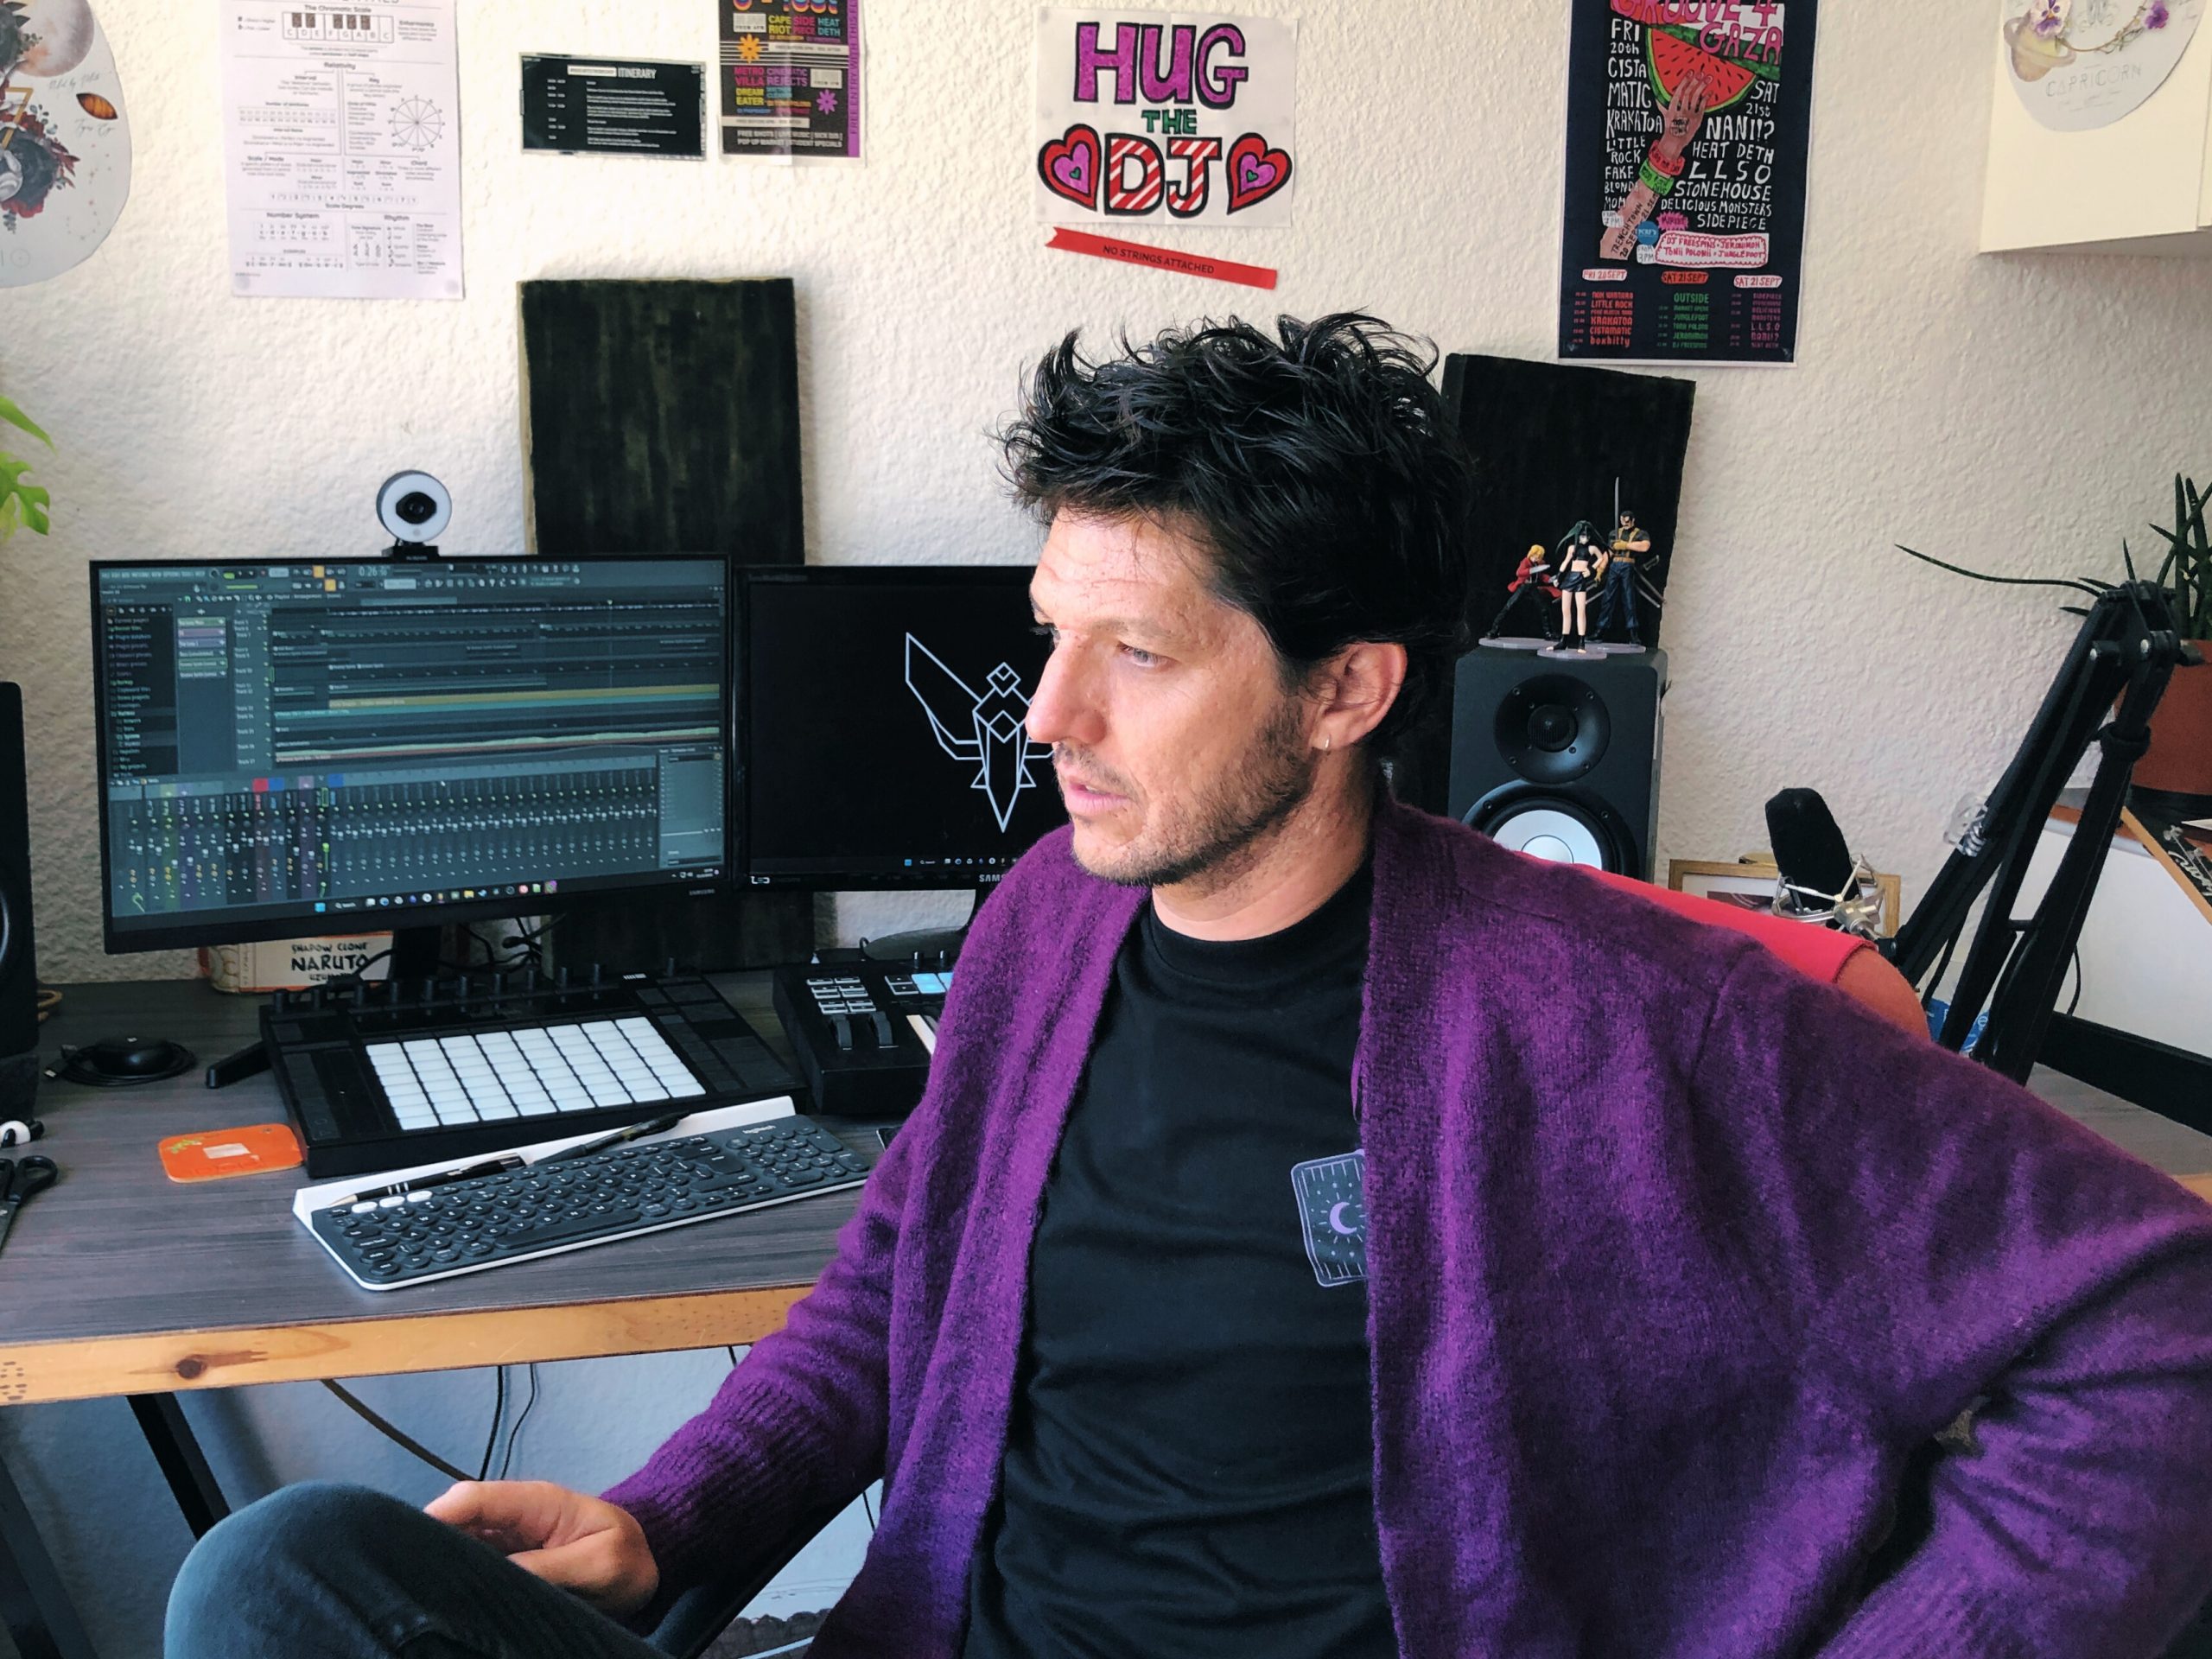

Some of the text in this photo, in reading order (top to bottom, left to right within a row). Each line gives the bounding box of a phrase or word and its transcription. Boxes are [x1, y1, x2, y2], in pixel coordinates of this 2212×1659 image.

[768, 16, 840, 27] CAPE SIDE HEAT
[1611, 18, 1640, 41] FRI
[768, 25, 791, 35] RIOT
[818, 27, 841, 37] DETH
[1610, 41, 1639, 54] 20th
[1700, 22, 1783, 65] GAZA
[617, 67, 657, 79] ITINERARY
[734, 67, 765, 76] METRO
[1073, 22, 1249, 111] HUG
[1607, 56, 1647, 79] CISTA
[735, 76, 765, 86] VILLA
[766, 76, 808, 86] REJECTS
[2045, 63, 2142, 98] CAPRICORN
[736, 97, 765, 105] EATER
[1607, 81, 1651, 109] MATIC
[1751, 80, 1780, 104] SAT
[1745, 103, 1771, 118] 21st
[1141, 108, 1198, 135] THE
[1605, 109, 1663, 139] KRAKATOA
[1606, 135, 1646, 153] LITTLE
[1692, 141, 1730, 159] HEAT
[1736, 143, 1775, 165] DETH
[1611, 149, 1642, 165] ROCK
[1104, 132, 1223, 219] DJ
[1674, 180, 1772, 201] STONEHOUSE
[1661, 198, 1772, 217] DELICIOUS MONSTERS
[1697, 213, 1766, 231] SIDEPIECE
[1103, 245, 1215, 275] NO STRINGS ATTACHED
[1735, 276, 1749, 287] SAT
[1759, 276, 1781, 286] SEPT
[1673, 293, 1710, 303] OUTSIDE
[1591, 316, 1633, 326] KRAKATOA
[291, 954, 370, 971] NARUTO
